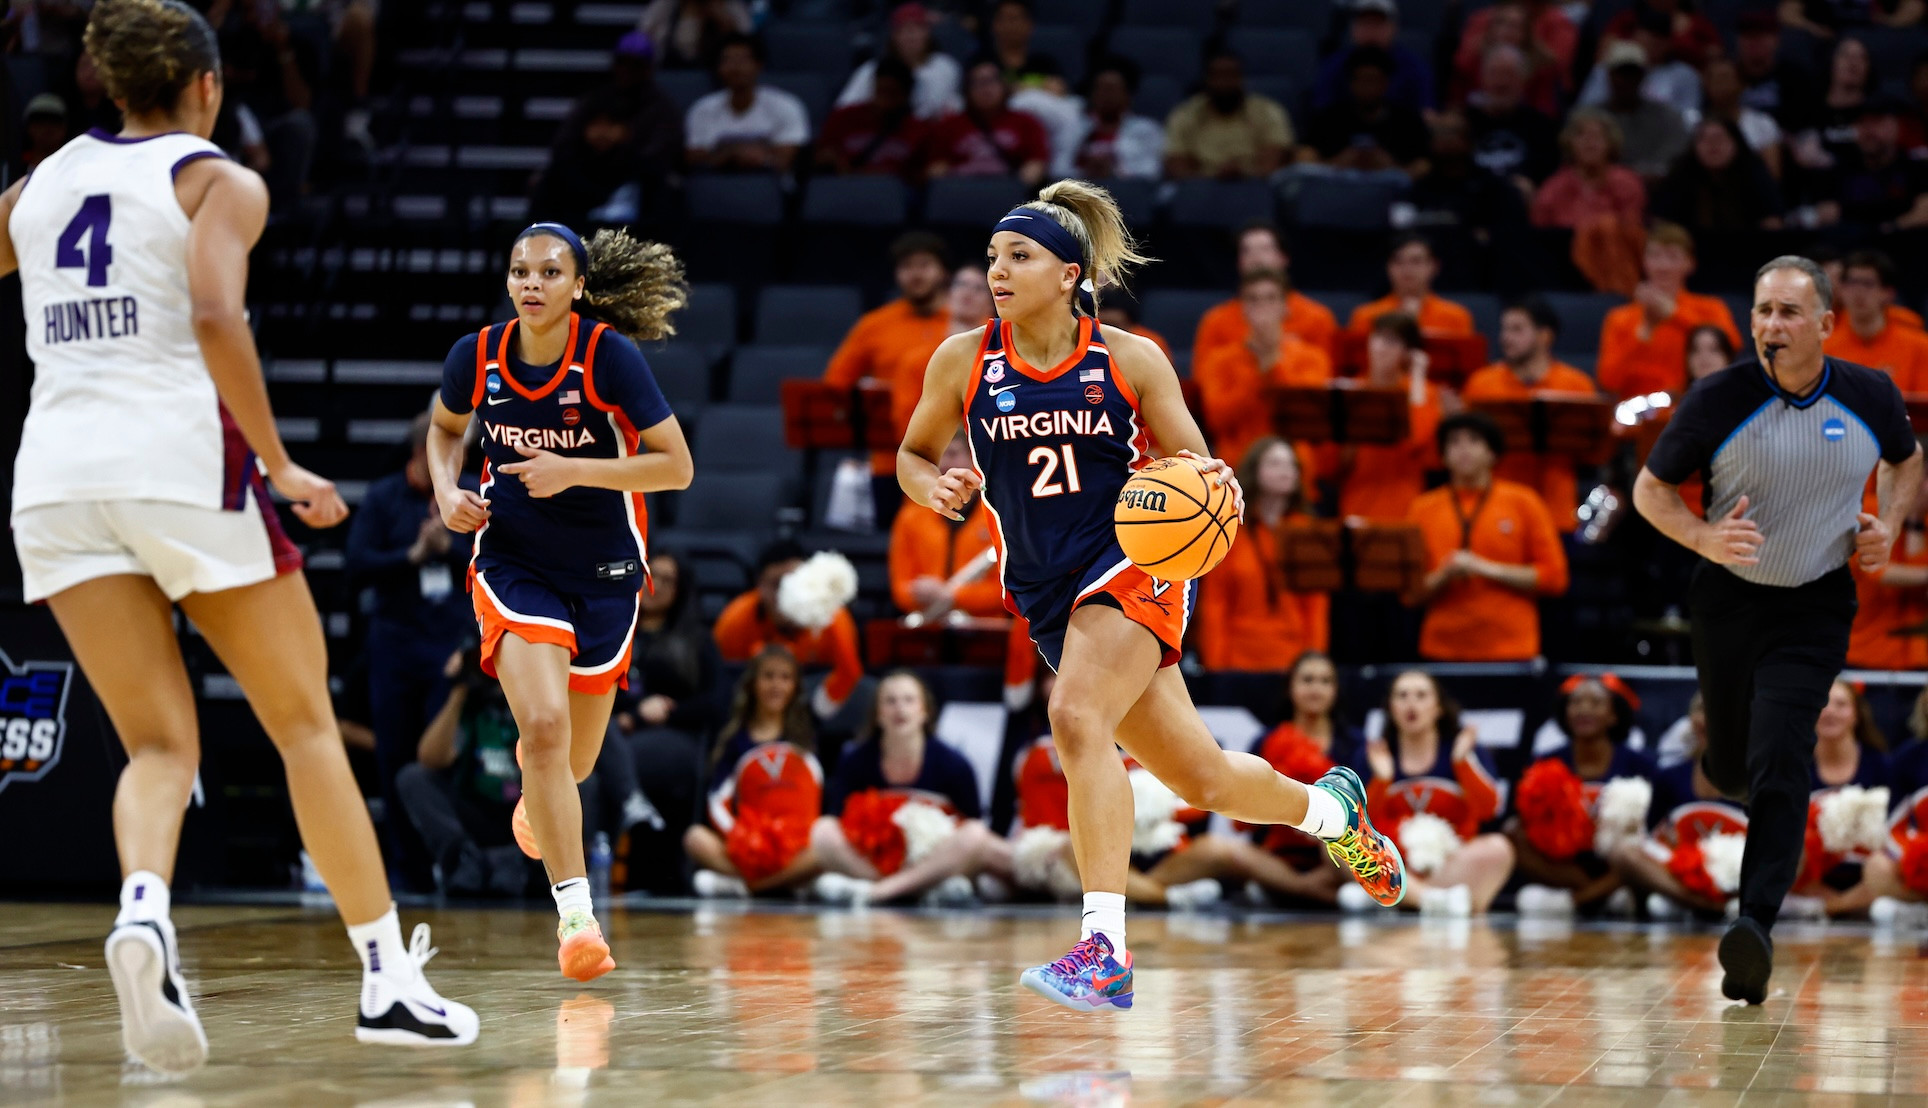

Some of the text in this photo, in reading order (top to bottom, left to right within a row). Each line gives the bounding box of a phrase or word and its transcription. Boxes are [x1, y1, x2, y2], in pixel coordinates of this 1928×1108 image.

[56, 193, 113, 287] 4
[44, 296, 138, 344] HUNTER
[484, 420, 596, 448] VIRGINIA
[980, 410, 1115, 442] VIRGINIA
[1027, 444, 1082, 498] 21
